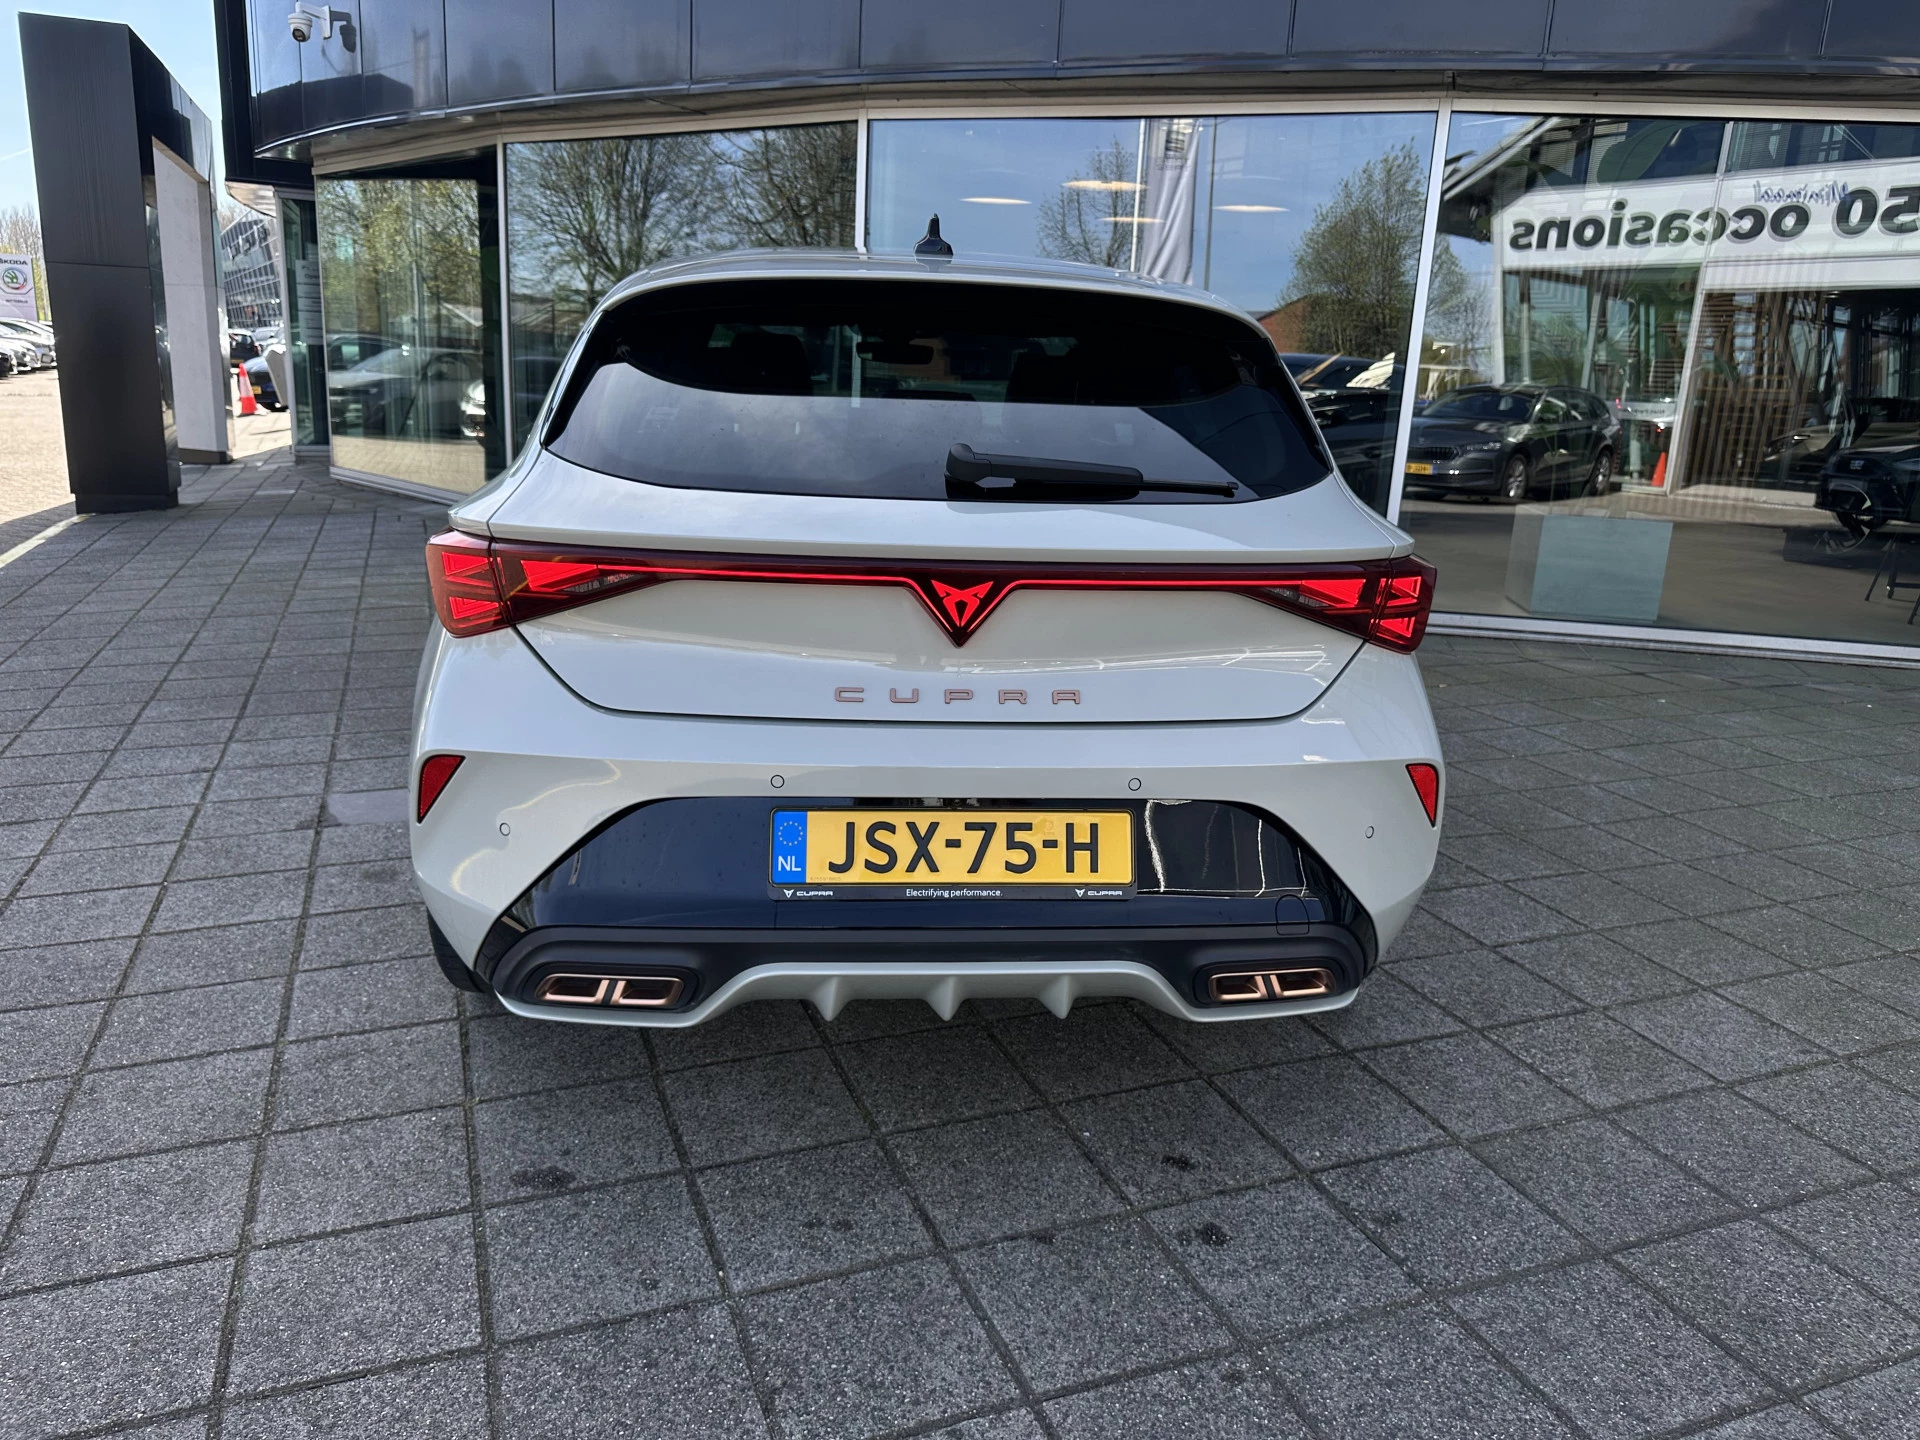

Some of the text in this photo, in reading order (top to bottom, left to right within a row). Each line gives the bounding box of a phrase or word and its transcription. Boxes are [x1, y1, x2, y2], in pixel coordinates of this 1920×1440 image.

[835, 687, 1080, 704] CUPRA
[828, 821, 1099, 874] JSX-75-H
[777, 855, 802, 872] NL
[906, 888, 1003, 898] Electrifying performance.
